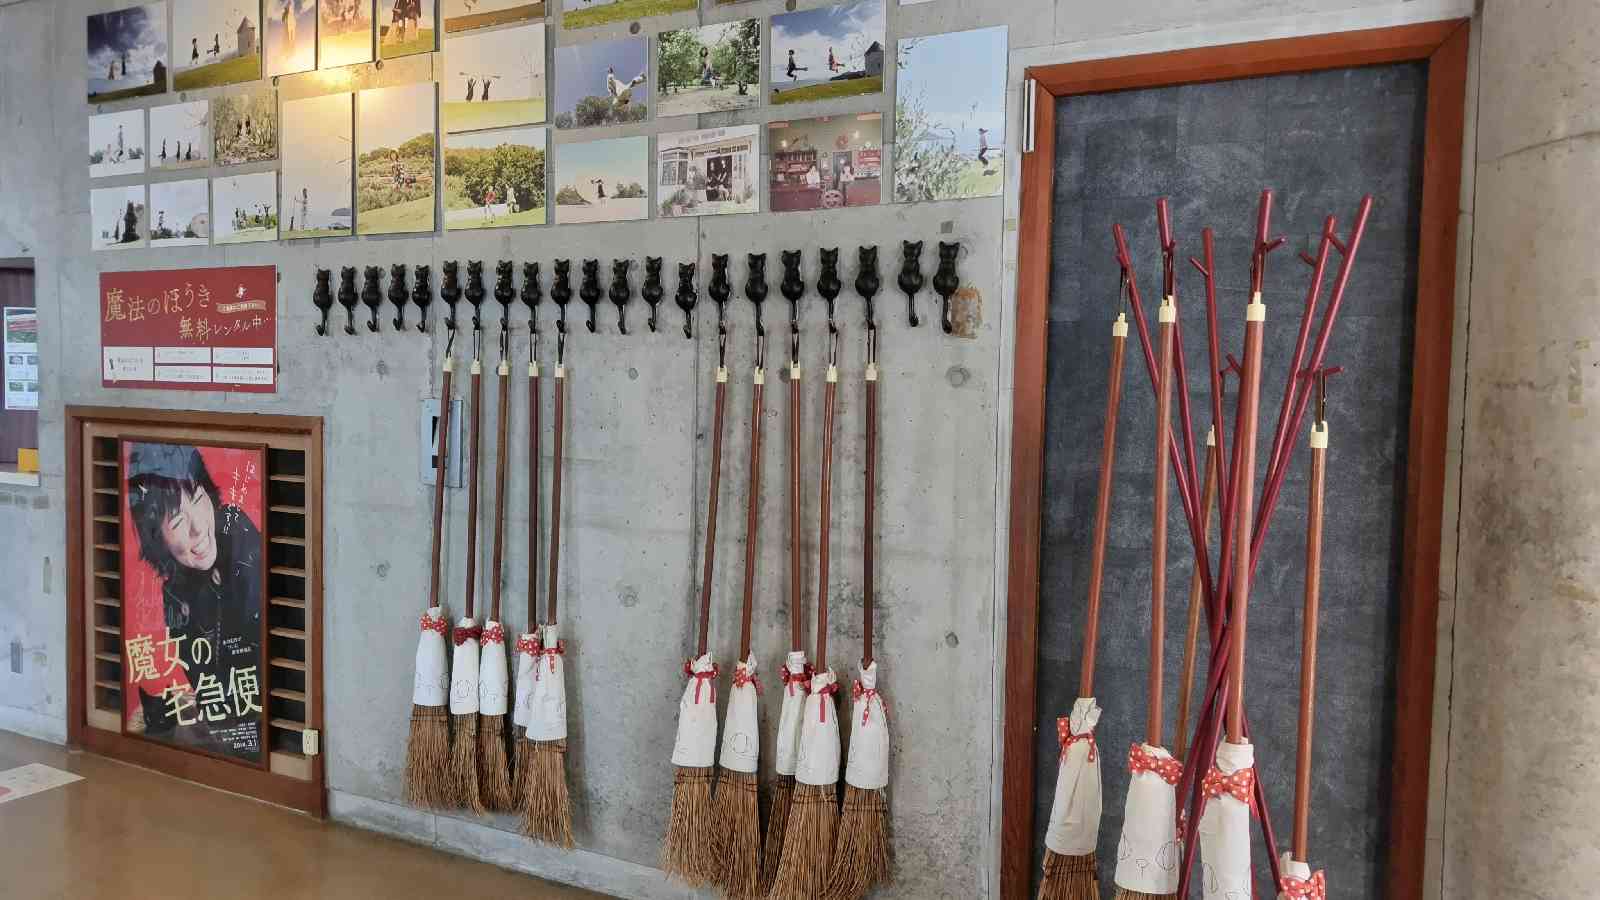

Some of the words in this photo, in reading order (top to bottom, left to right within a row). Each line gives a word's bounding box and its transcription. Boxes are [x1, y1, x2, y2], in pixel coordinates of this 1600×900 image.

[104, 282, 211, 322] 魔法のほうき
[125, 626, 212, 684] 魔女の
[161, 665, 263, 726] 宅急便
